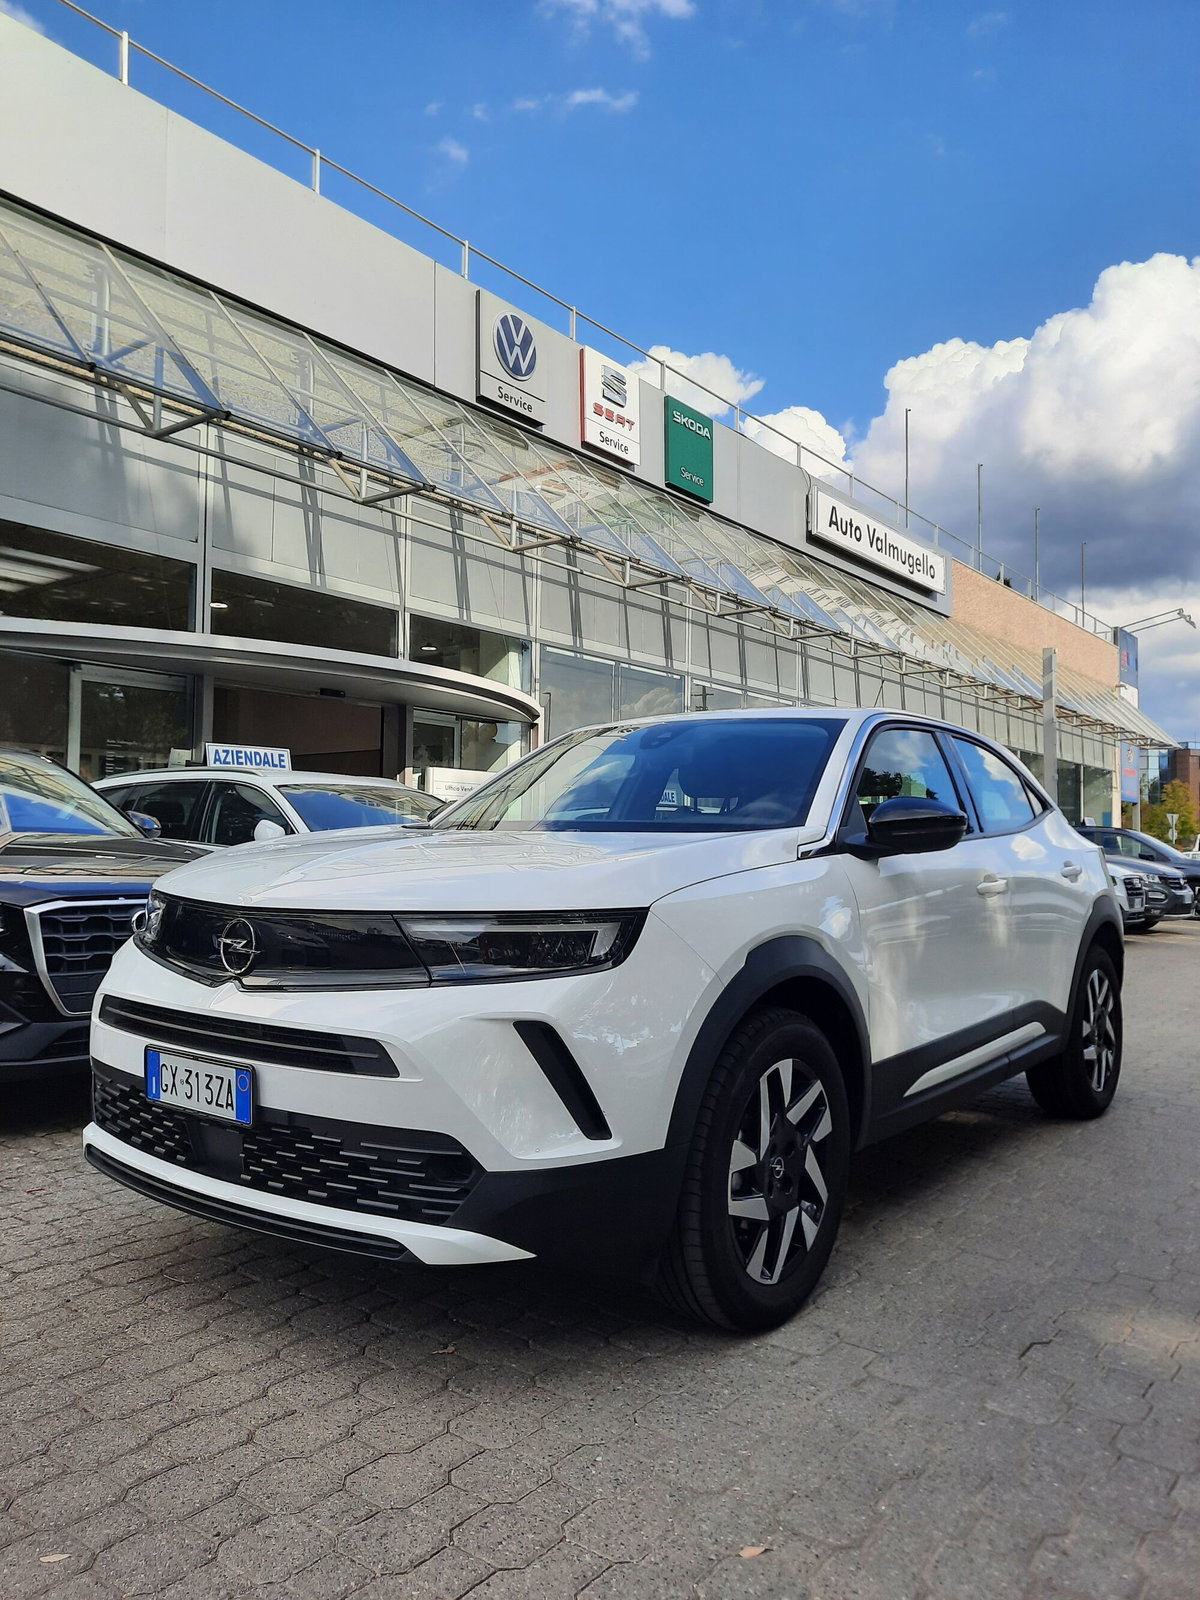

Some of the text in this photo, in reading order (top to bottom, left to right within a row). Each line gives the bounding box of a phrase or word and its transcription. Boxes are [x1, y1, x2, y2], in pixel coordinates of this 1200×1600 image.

[497, 385, 533, 413] Service
[592, 402, 636, 432] SEAT
[599, 430, 629, 455] Service
[680, 466, 704, 487] Service
[828, 505, 936, 579] Auto Valmugello
[213, 748, 287, 769] AZIENDALE
